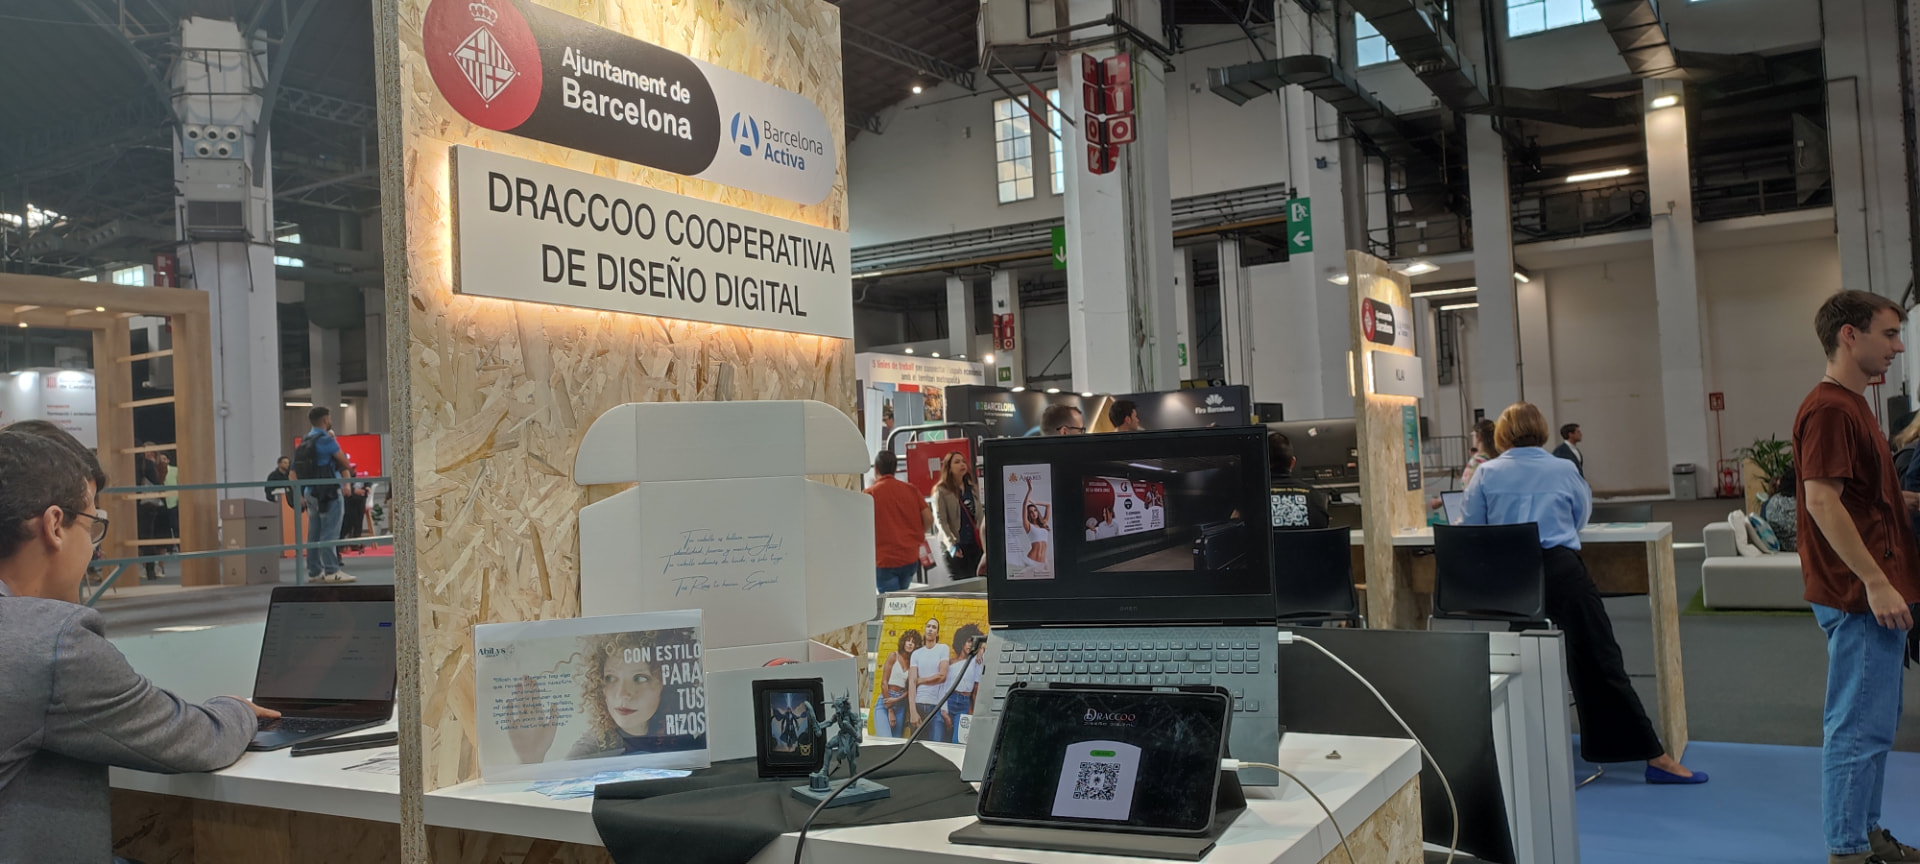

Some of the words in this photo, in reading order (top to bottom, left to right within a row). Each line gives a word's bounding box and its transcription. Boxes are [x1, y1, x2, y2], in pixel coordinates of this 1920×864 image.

[561, 46, 667, 97] Ajuntament
[670, 80, 691, 104] de
[562, 76, 693, 140] Barcelona
[764, 120, 823, 155] Barcelona
[764, 143, 805, 171] Activa
[488, 171, 656, 240] DRACCOO
[665, 209, 835, 273] COOPERATIVA
[542, 243, 587, 287] DE
[597, 255, 706, 303] DISEÑO
[715, 272, 807, 317] DIGITAL
[623, 646, 651, 664] CON
[655, 643, 702, 661] ESTILO
[661, 661, 703, 685] PARA
[677, 687, 704, 710] TUS
[665, 712, 706, 739] RIZOS
